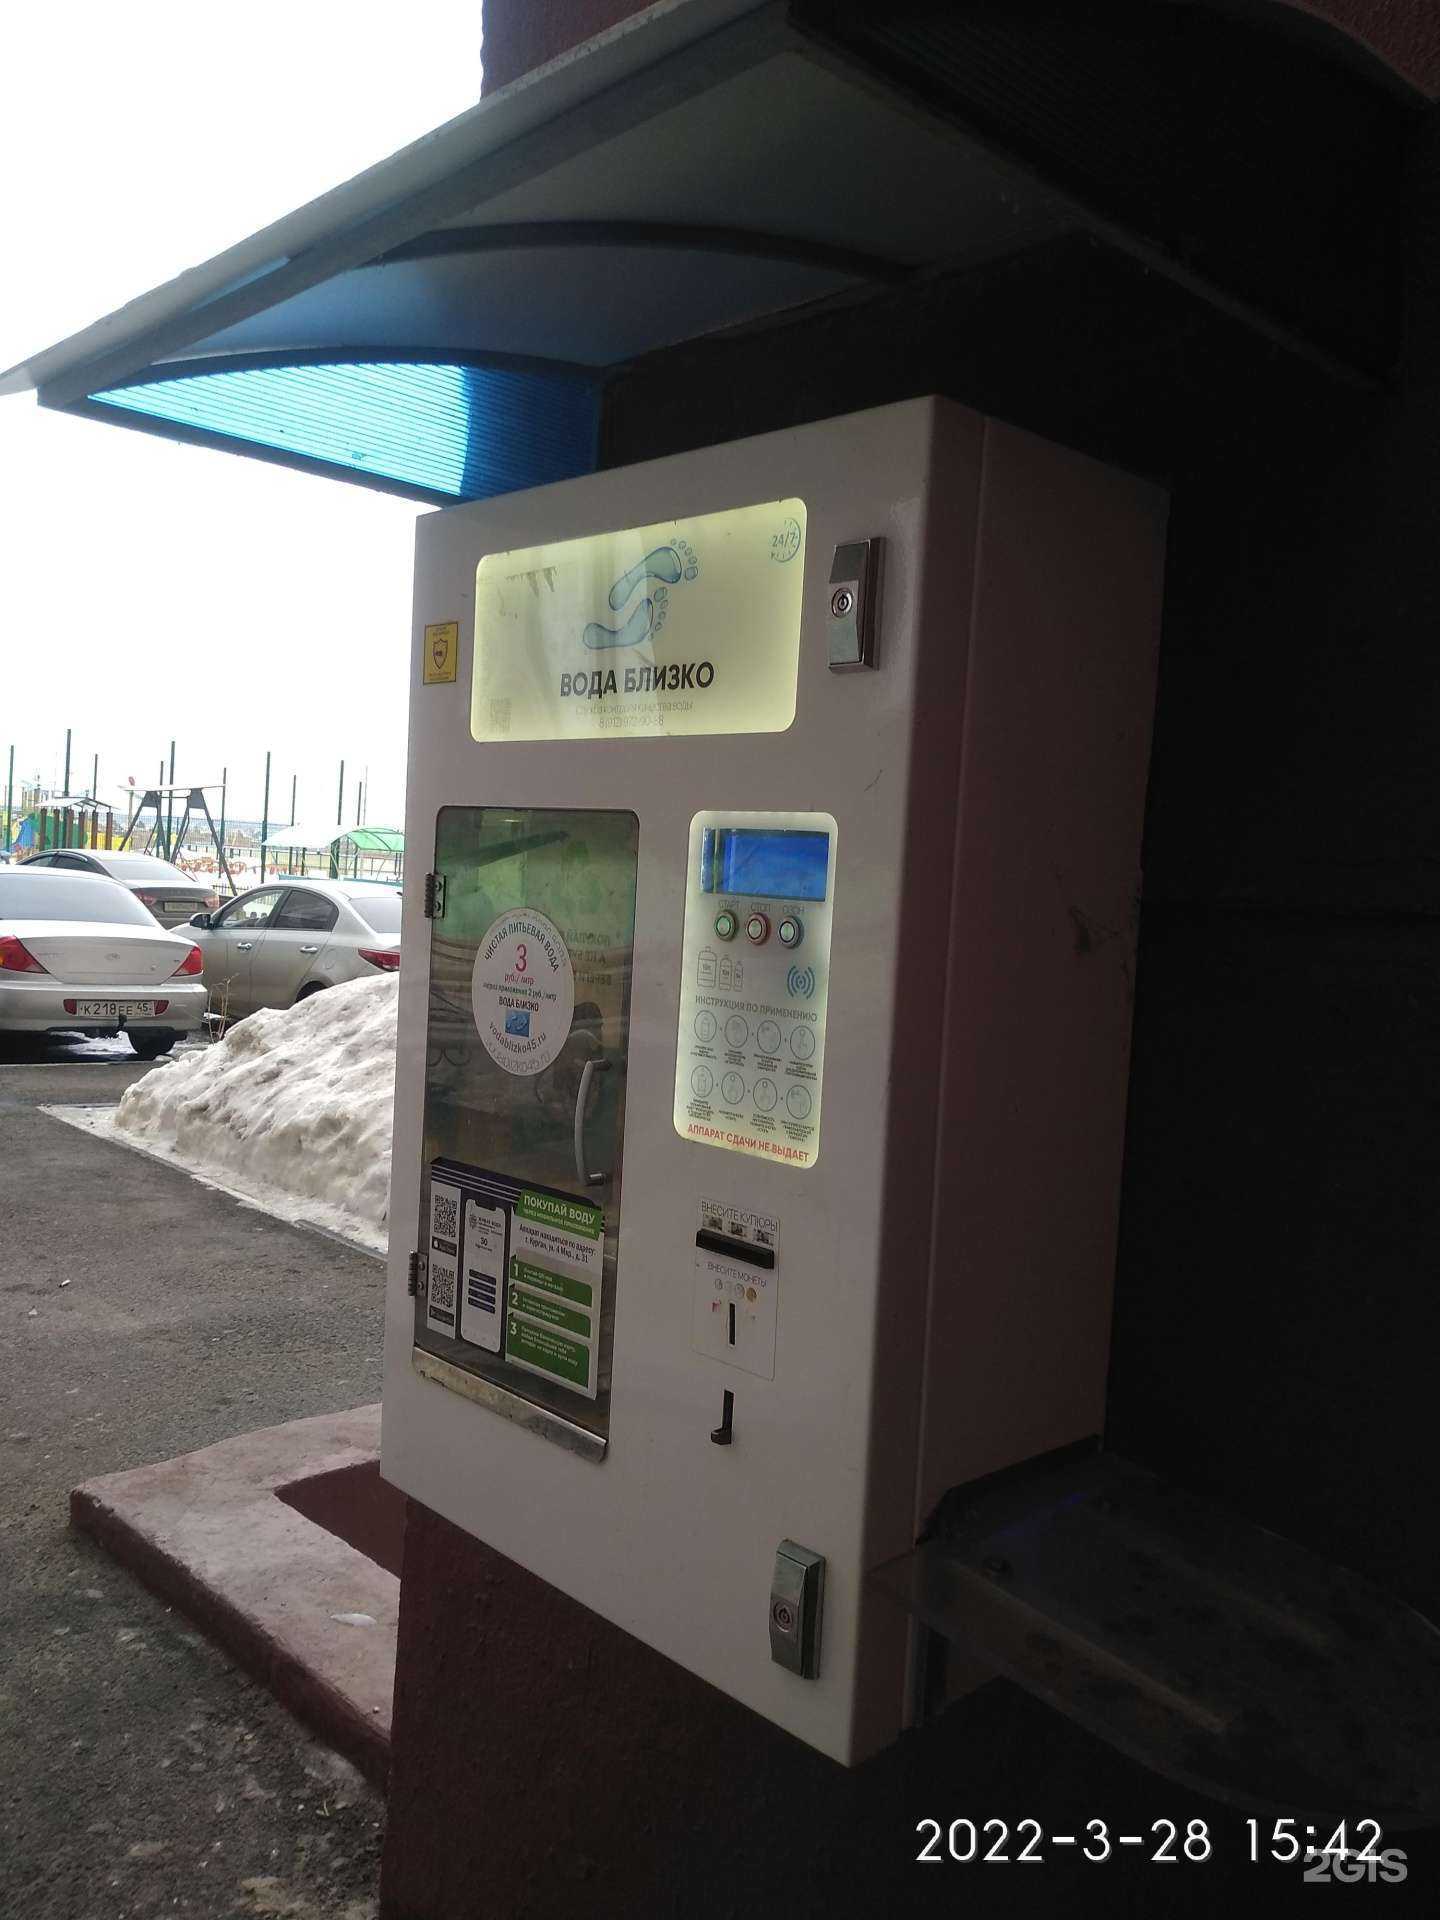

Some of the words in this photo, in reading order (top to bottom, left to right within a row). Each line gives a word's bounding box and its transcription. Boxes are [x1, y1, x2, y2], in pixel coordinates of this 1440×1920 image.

[771, 530, 796, 548] 24/7
[560, 669, 617, 699] ВОДА
[624, 660, 715, 694] БЛИЗКО
[484, 927, 508, 961] ЧИСТАЯ
[508, 921, 545, 945] ПИТЬЕВАЯ
[543, 940, 560, 973] ВОДА
[515, 943, 527, 972] 3
[136, 1002, 149, 1013] 45
[498, 996, 515, 1008] ВОДА
[515, 999, 539, 1012] БЛИЗКО
[695, 995, 745, 1011] ИНСТРУКЦИЯ
[746, 1003, 758, 1013] ПО
[760, 1004, 817, 1023] ПРИМЕНЕНИЮ
[488, 1022, 547, 1054] vodablizko45.ru
[687, 1123, 725, 1141] АППАРАТ
[726, 1132, 756, 1148] СДАЧИ
[758, 1142, 770, 1152] НЕ
[772, 1144, 810, 1162] ВЫДАЕТ
[524, 1194, 567, 1218] ПОКУПАЙ
[569, 1207, 595, 1225] ВОДУ
[700, 1200, 739, 1220] ВНЕСИТЕ
[739, 1209, 778, 1233] КУПЮРЫ
[519, 1224, 539, 1237] Аппарат
[514, 1264, 519, 1277] 1
[707, 1261, 738, 1279] ВНЕСИТЕ
[736, 1270, 767, 1288] МОНЕТЫ
[511, 1292, 518, 1306] 2
[510, 1321, 517, 1335] 3
